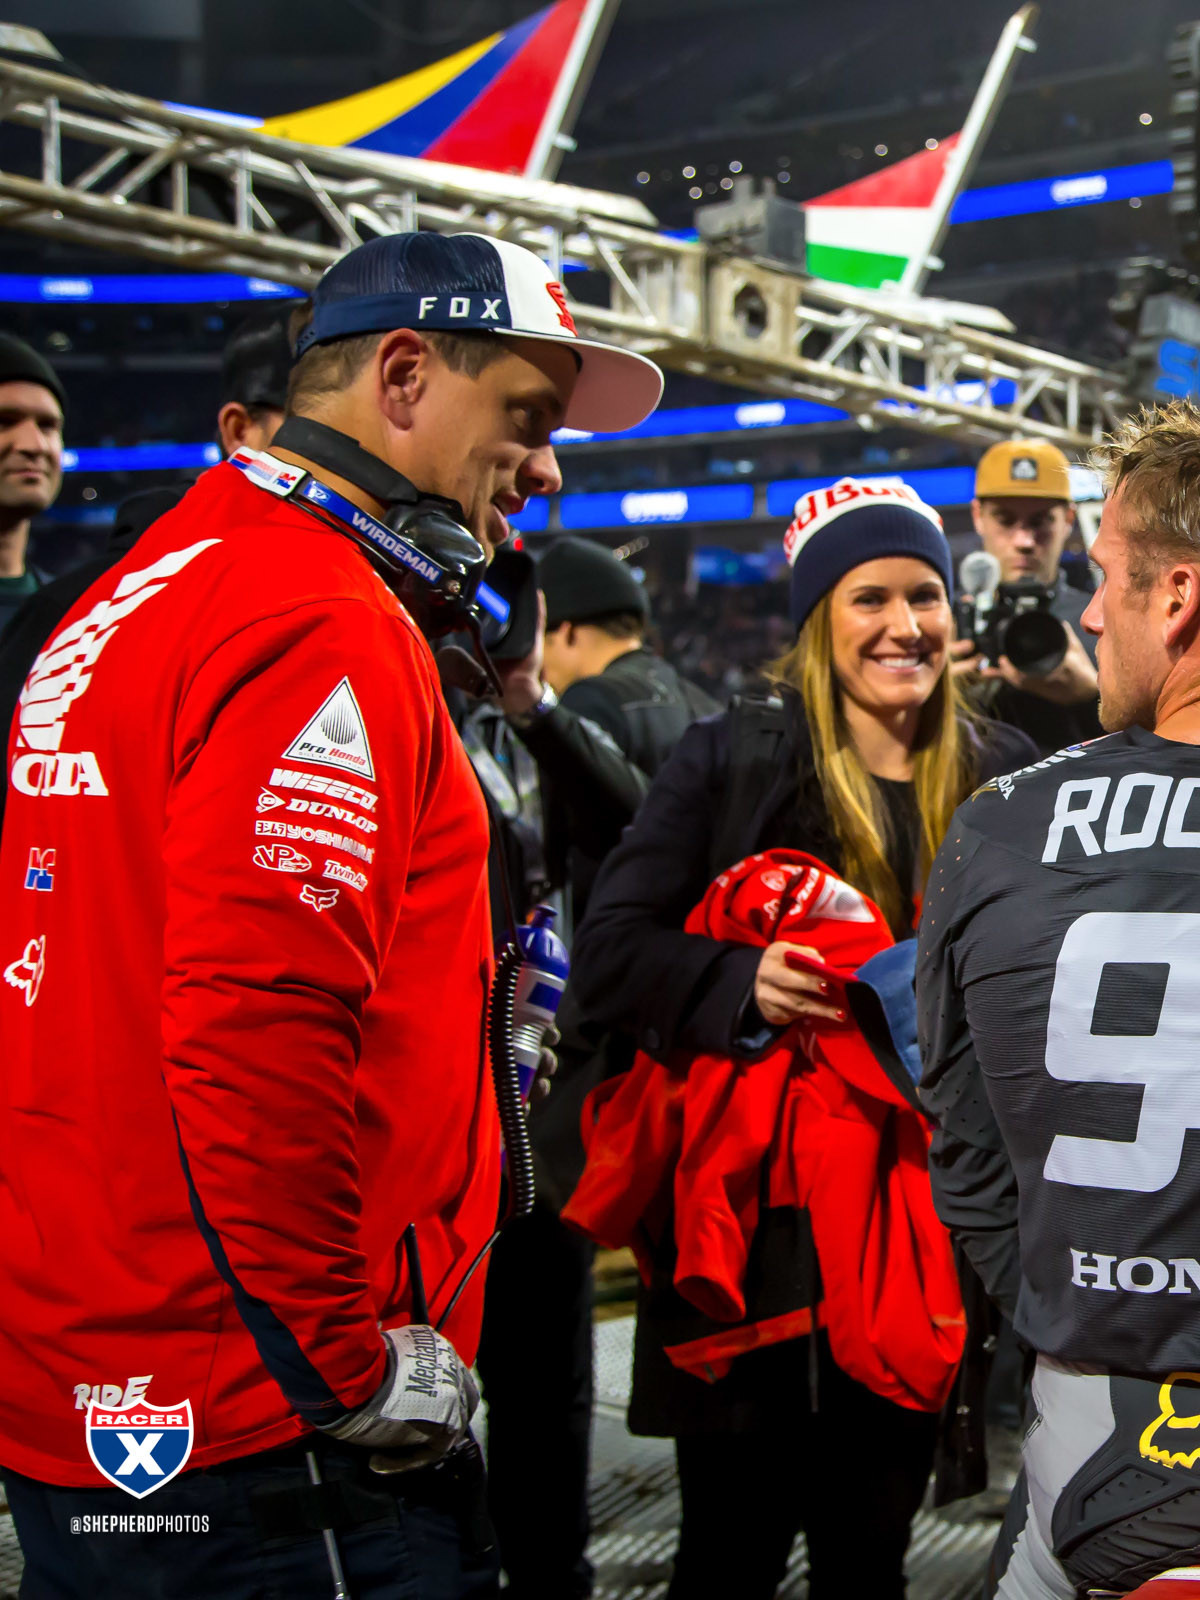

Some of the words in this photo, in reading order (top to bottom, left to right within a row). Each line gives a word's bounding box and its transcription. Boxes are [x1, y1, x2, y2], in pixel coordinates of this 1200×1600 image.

[418, 296, 502, 320] FOX
[352, 511, 440, 583] WIRDEMAN
[299, 742, 326, 754] Pro
[328, 748, 366, 766] Honda
[285, 798, 378, 833] DUNLOP
[255, 844, 297, 870] VP
[325, 861, 356, 882] Twin
[405, 1328, 438, 1398] Mechanix
[73, 1374, 154, 1410] RIDE
